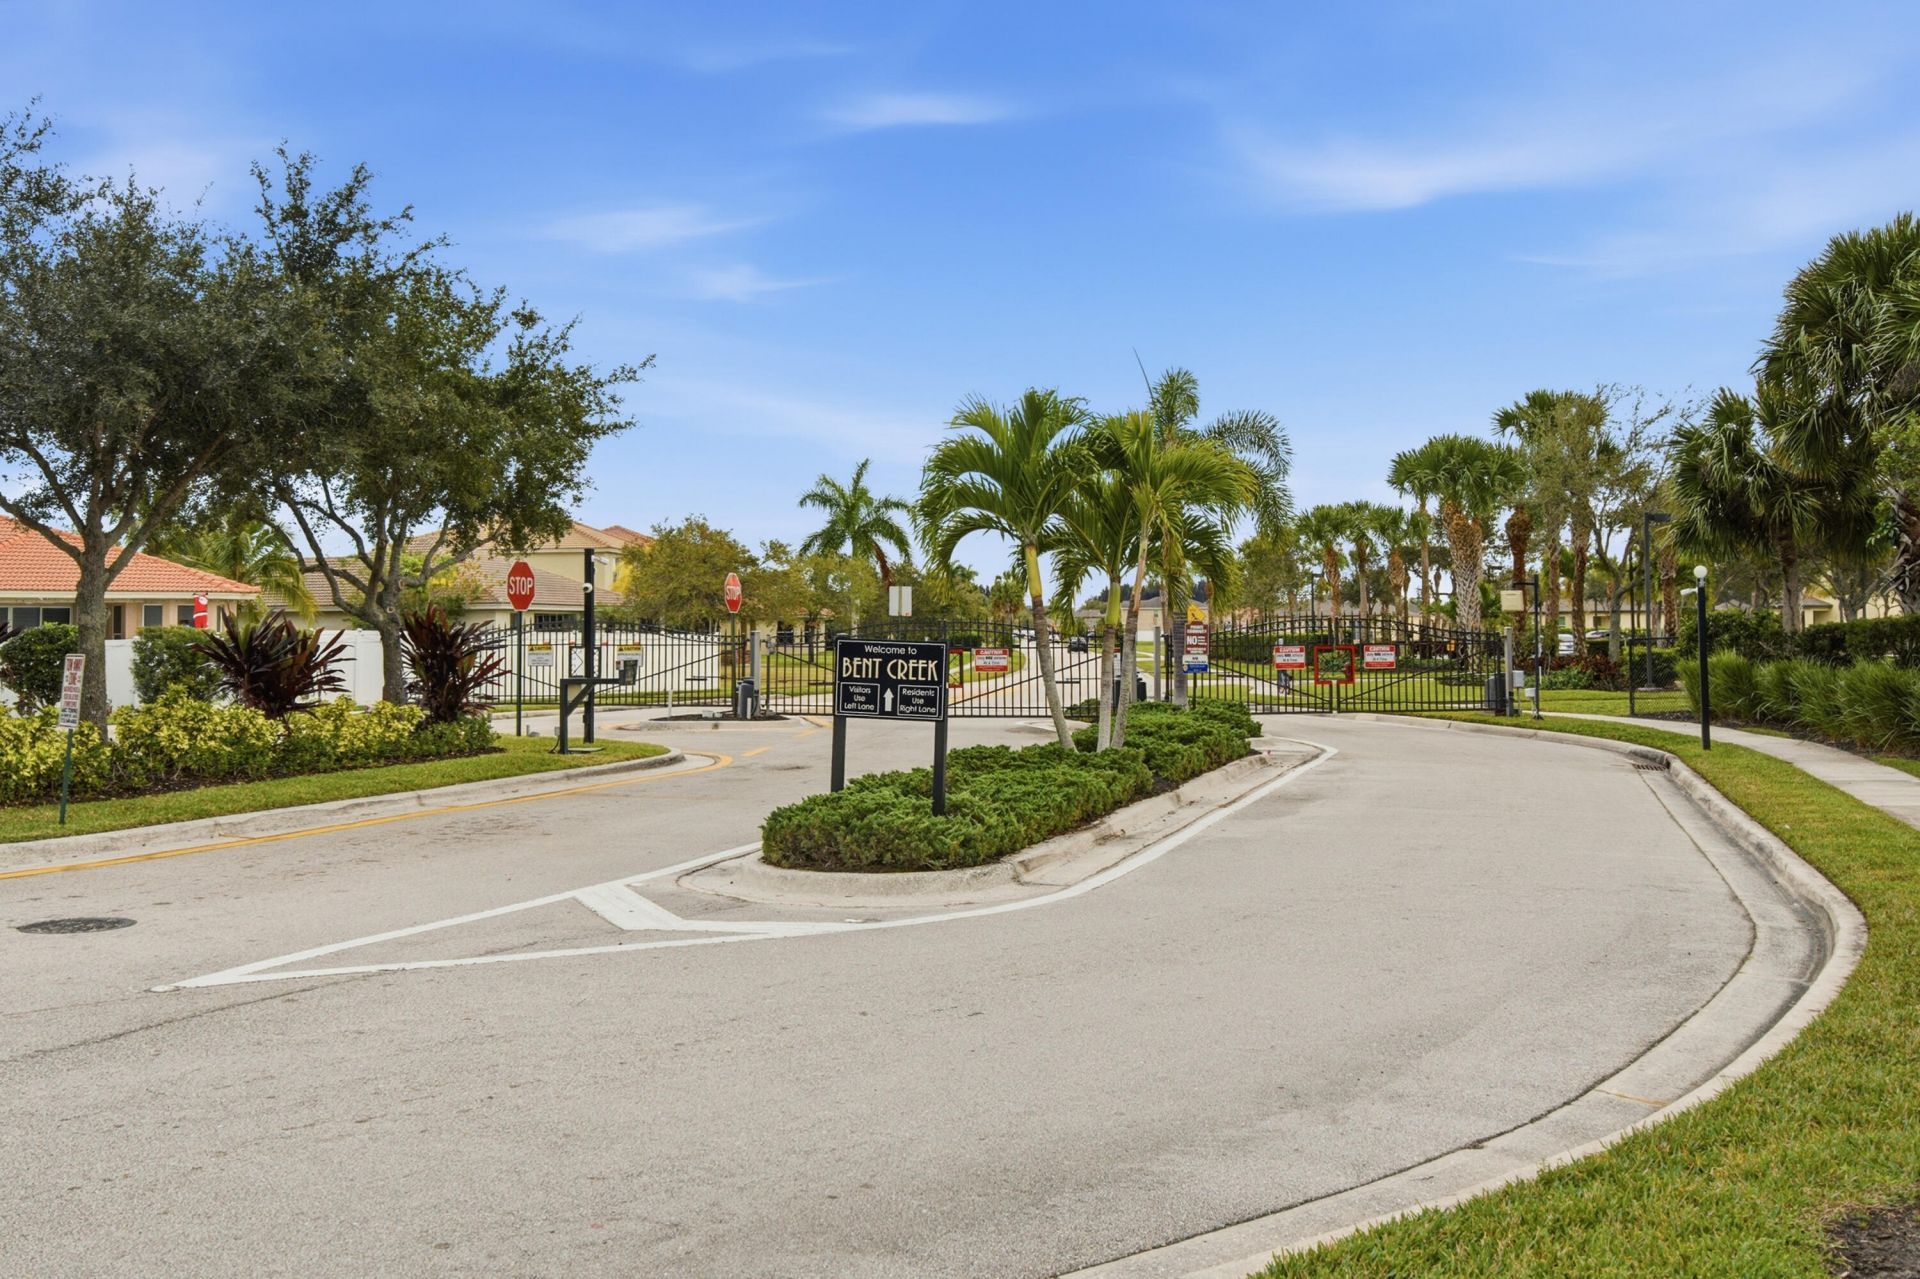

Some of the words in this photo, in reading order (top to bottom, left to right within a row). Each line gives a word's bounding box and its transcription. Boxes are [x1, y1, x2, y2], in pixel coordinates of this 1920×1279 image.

[509, 576, 533, 595] STOP
[726, 585, 741, 600] STOP
[1187, 636, 1198, 645] NO
[864, 645, 906, 654] Welcome
[908, 646, 917, 654] to
[842, 657, 882, 678] BENT
[887, 659, 938, 681] CREEK
[849, 685, 871, 693] Visitors
[902, 688, 935, 696] Residents
[900, 704, 916, 713] Right
